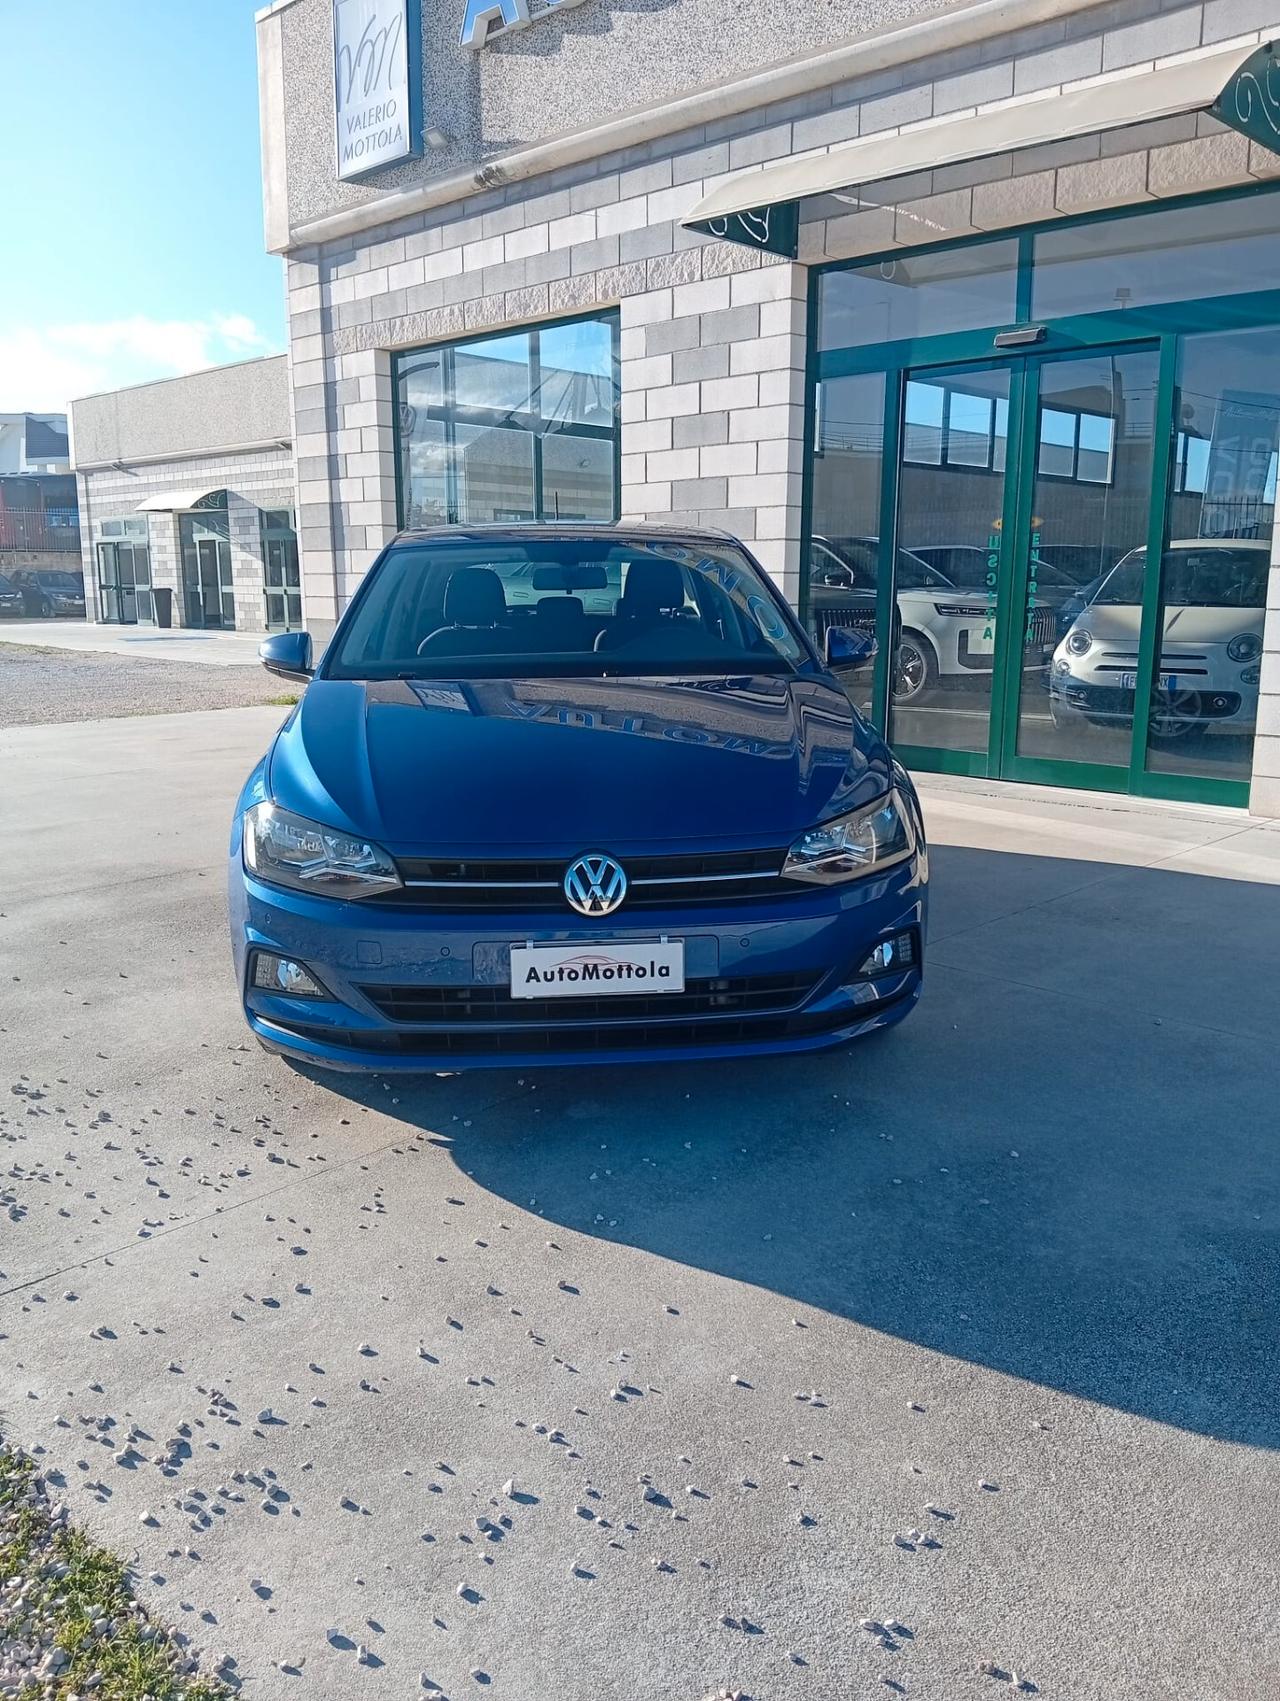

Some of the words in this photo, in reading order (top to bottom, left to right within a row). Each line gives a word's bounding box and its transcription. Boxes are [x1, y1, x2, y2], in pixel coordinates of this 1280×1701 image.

[346, 98, 397, 134] VALERIO
[342, 123, 402, 163] MOTTOLA
[1025, 532, 1041, 641] ENTRATA
[525, 960, 671, 984] AutoMottola
